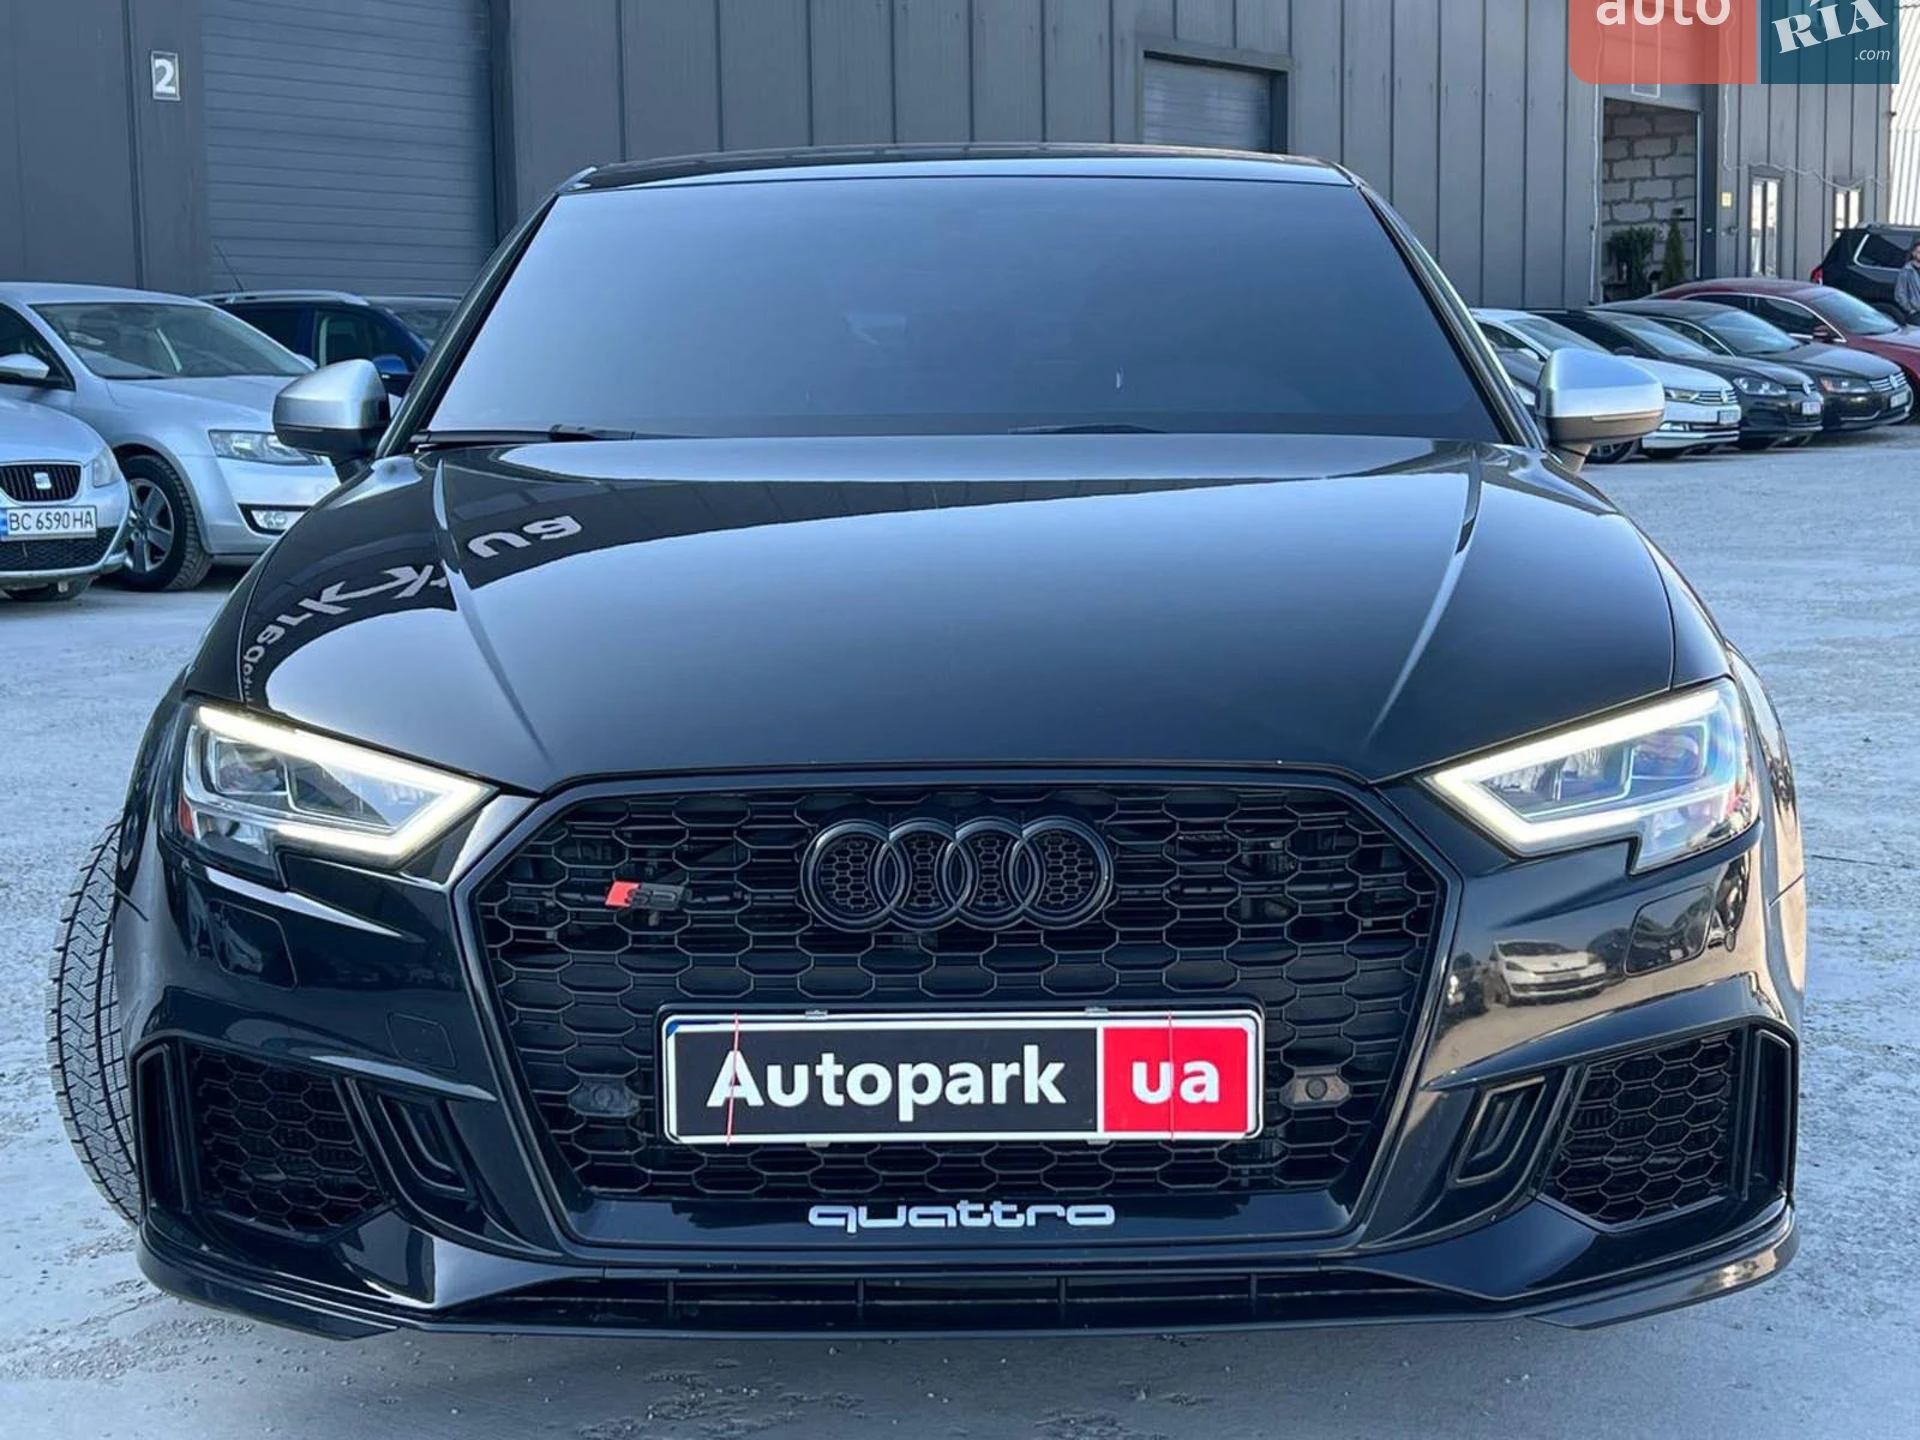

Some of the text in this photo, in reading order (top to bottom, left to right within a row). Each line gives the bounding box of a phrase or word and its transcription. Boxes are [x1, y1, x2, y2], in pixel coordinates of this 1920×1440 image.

[155, 58, 176, 93] 2
[9, 510, 93, 531] BC 6590 HA
[706, 1044, 1220, 1122] Autopark ua
[807, 1199, 1116, 1233] quattro
